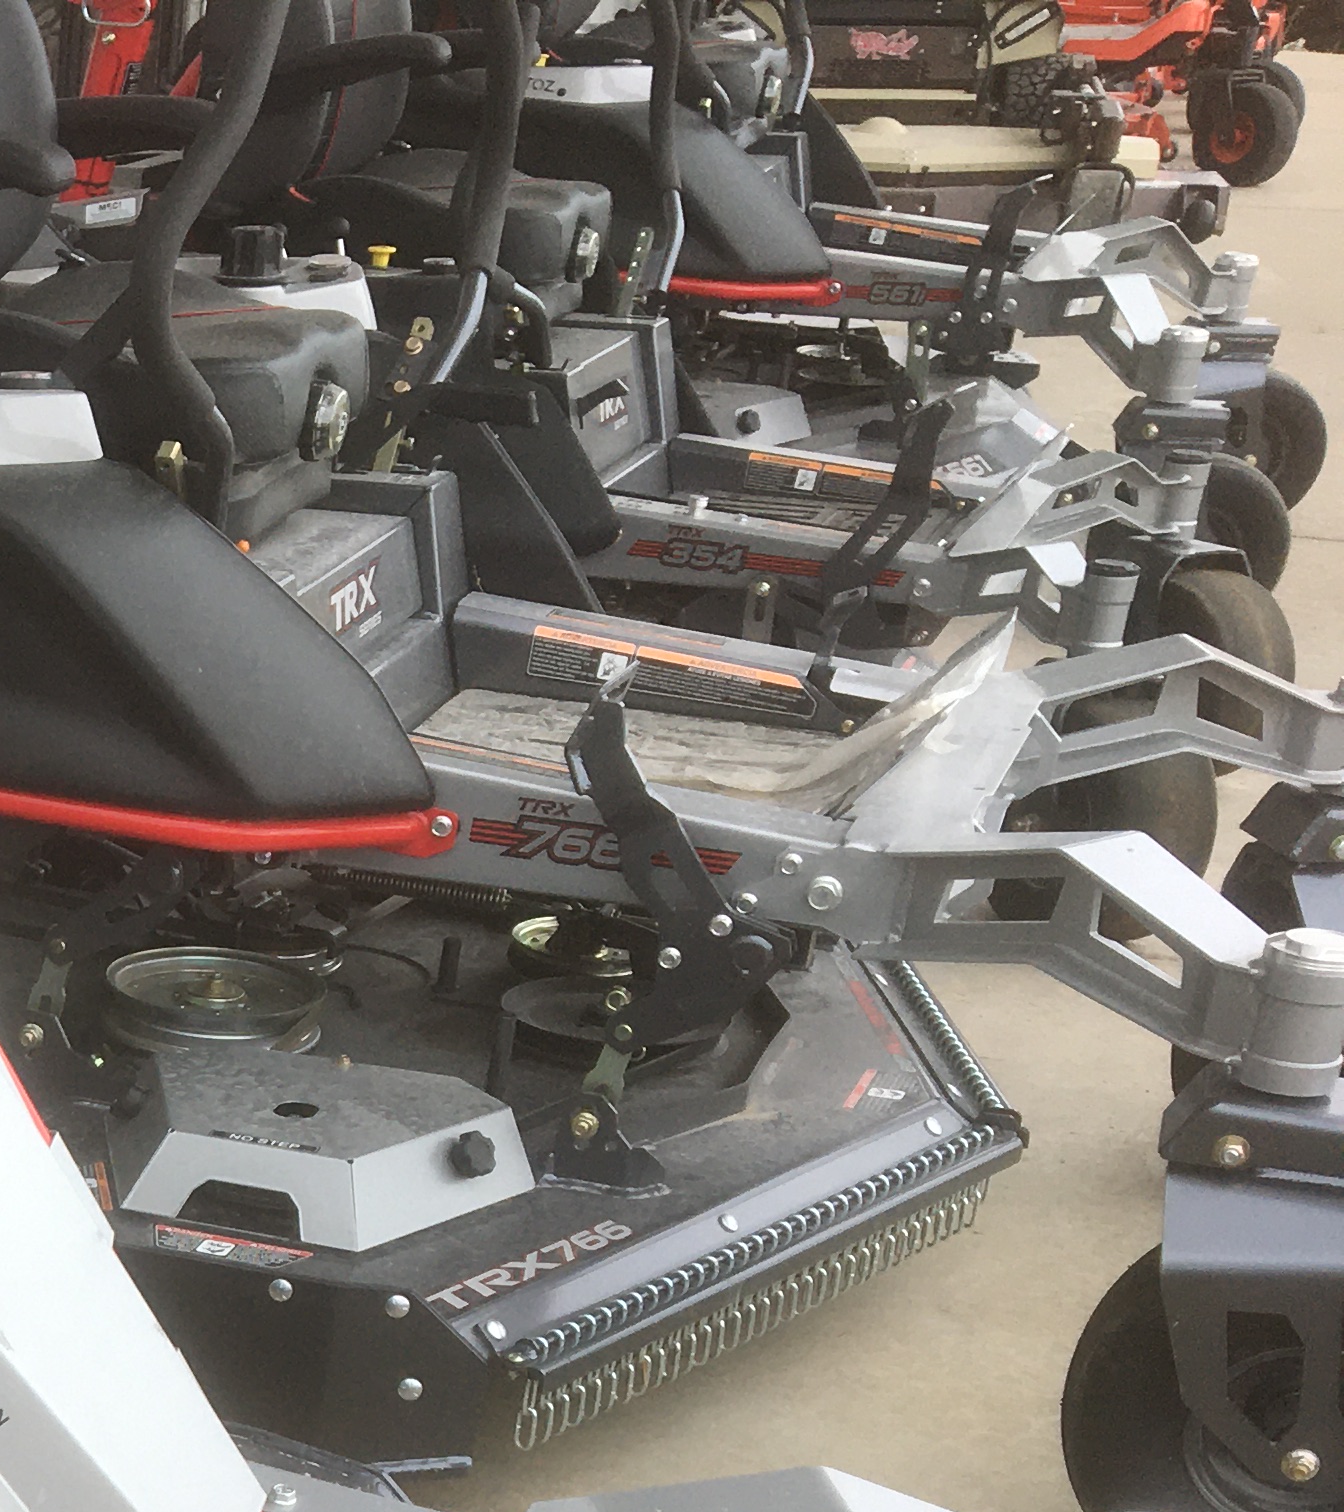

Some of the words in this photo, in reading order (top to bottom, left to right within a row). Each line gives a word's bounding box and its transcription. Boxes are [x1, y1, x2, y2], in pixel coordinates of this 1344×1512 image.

[661, 539, 747, 572] 354
[330, 565, 377, 632] TRX
[519, 796, 576, 818] TRX
[229, 1132, 254, 1142] NO
[257, 1137, 301, 1149] STEP
[425, 1219, 632, 1310] TRX766
